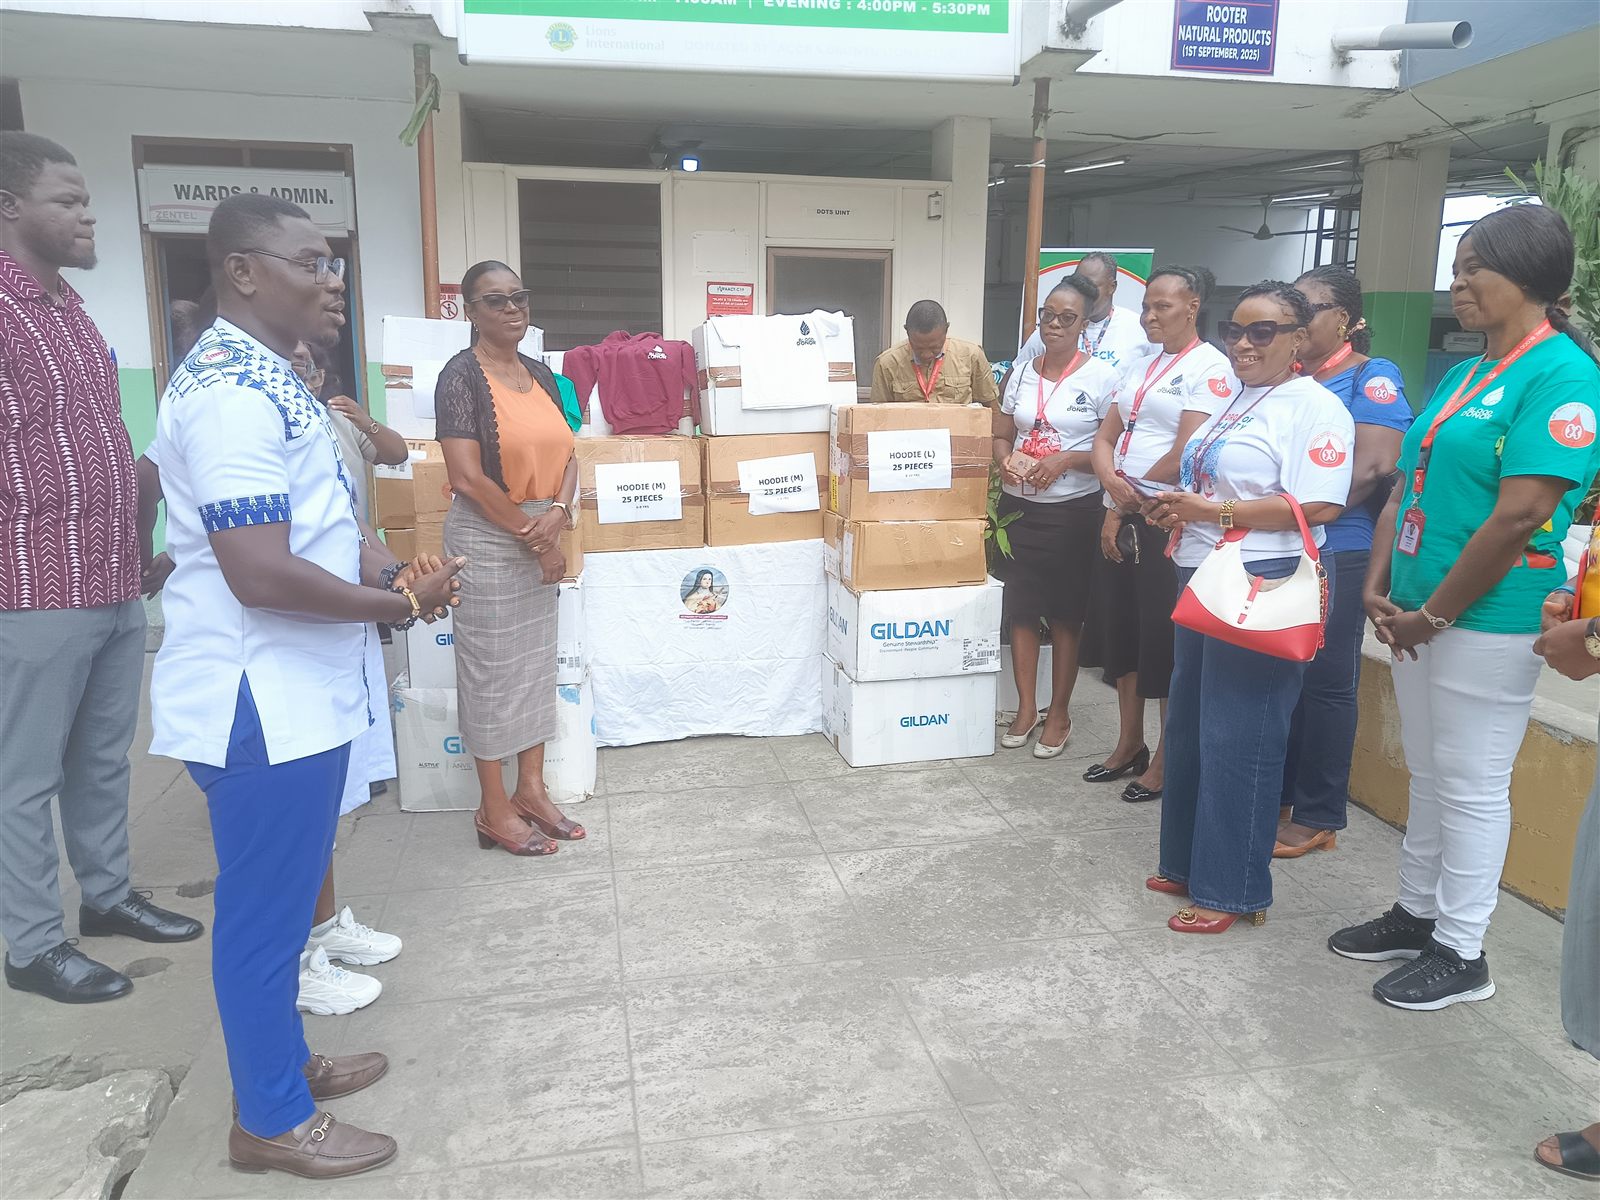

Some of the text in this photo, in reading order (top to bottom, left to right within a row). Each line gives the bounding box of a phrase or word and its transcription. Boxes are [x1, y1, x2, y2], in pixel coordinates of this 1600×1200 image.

[856, 0, 917, 13] 4:00PM
[932, 2, 991, 16] 5:30PM
[1206, 5, 1248, 24] ROOTER
[586, 24, 617, 37] Lions
[1178, 25, 1272, 46] NATURAL PRODUCTS
[586, 39, 665, 51] International
[1182, 44, 1260, 61] (1ST SEPTEMBER, 2025)
[173, 184, 241, 201] WARDS
[269, 187, 334, 204] ADMIN.
[155, 210, 197, 220] ZENTEL
[890, 450, 936, 460] HOODIE (L)
[892, 462, 934, 471] 25 PIECES
[758, 473, 804, 486] HOODIE (M)
[616, 482, 666, 492] HOODIE (M)
[764, 486, 802, 496] 25 PIECES
[622, 494, 664, 503] 25 PIECES
[870, 619, 952, 640] GILDAN
[900, 714, 949, 728] GILDAN
